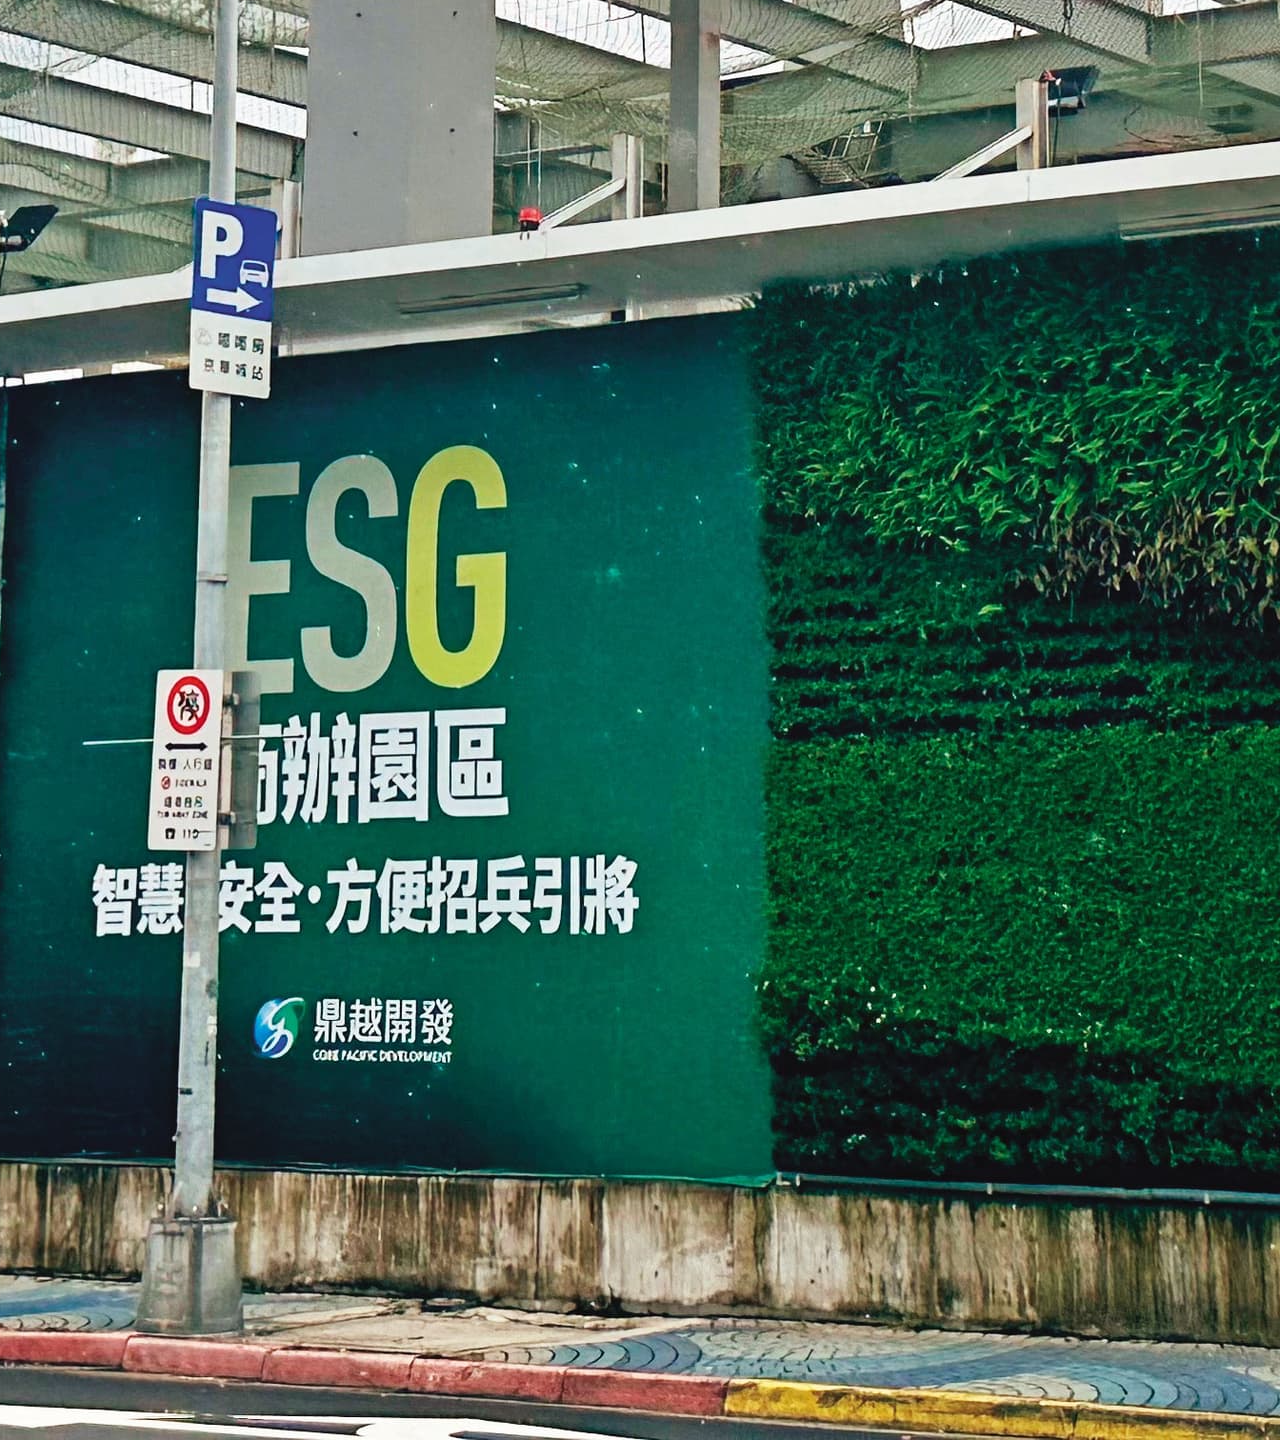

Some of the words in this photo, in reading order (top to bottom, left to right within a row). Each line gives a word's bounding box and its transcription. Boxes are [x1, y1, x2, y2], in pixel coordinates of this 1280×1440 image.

[200, 210, 243, 278] P
[227, 445, 507, 692] ESG
[314, 997, 454, 1045] 鼎越開發
